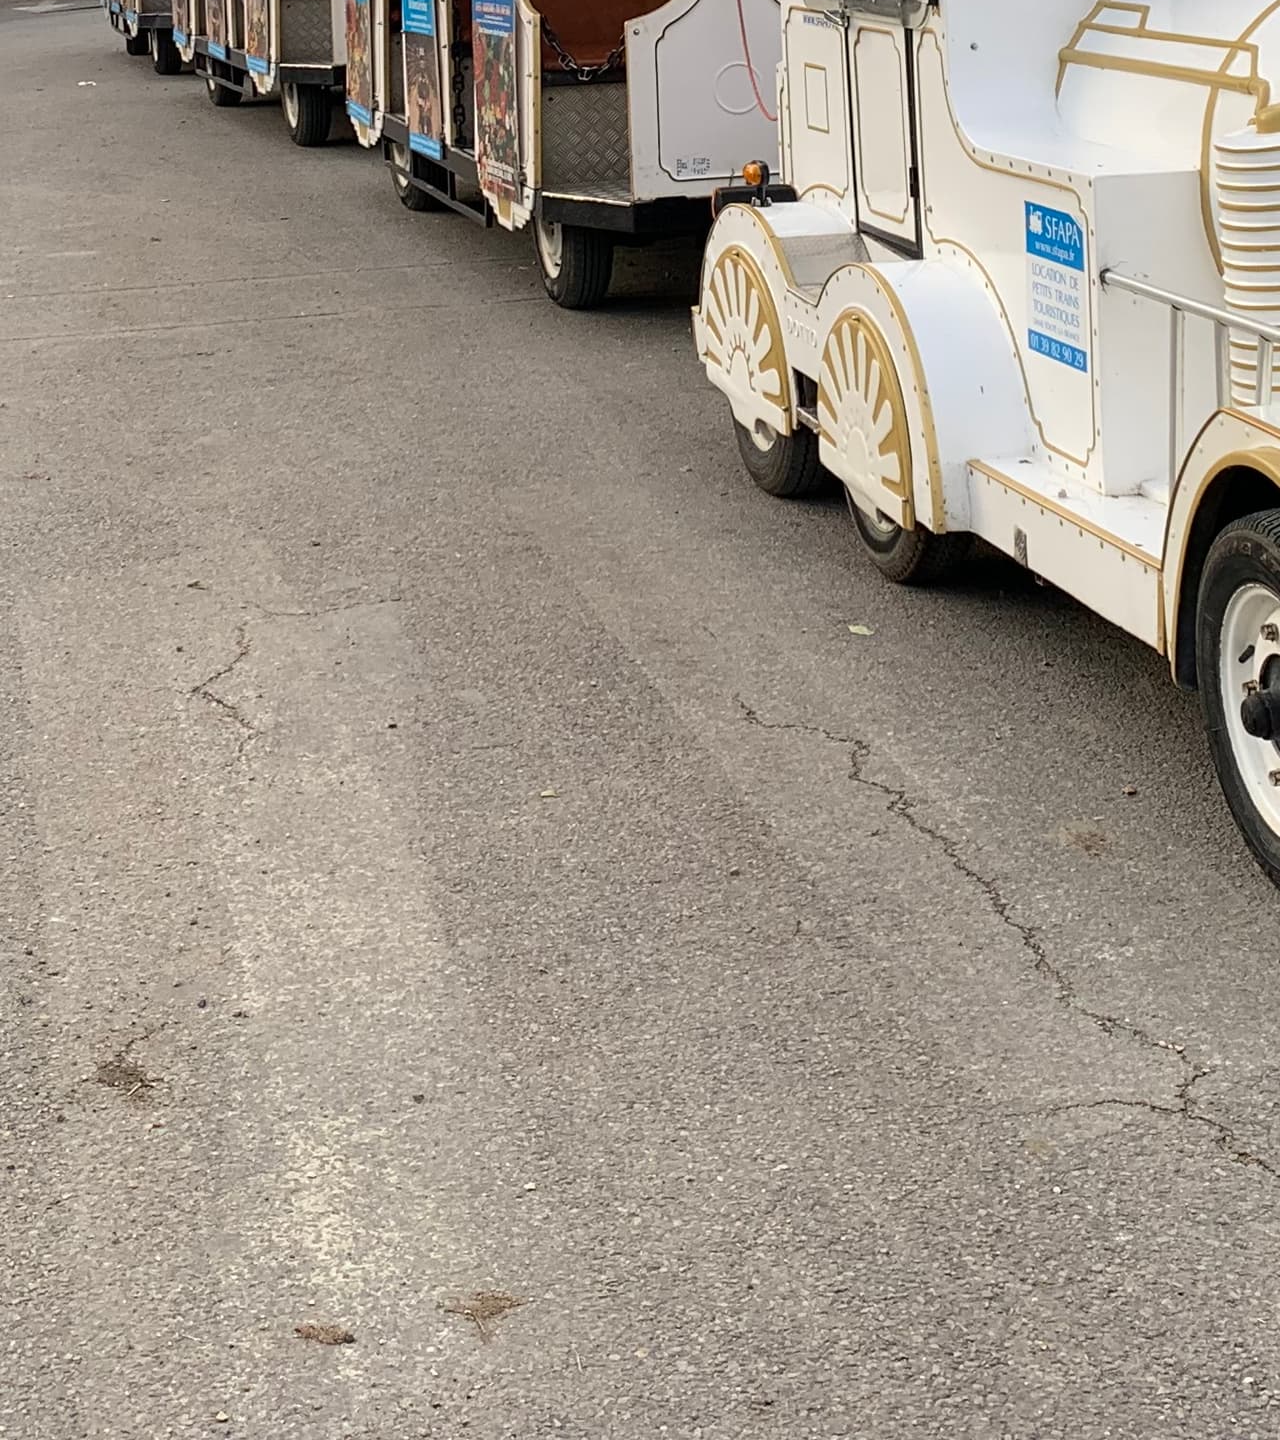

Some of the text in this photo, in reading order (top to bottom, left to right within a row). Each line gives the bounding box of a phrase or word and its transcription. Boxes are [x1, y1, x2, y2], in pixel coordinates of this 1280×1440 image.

[1045, 215, 1081, 248] SFAPA
[1032, 263, 1080, 291] LOCATION DE
[1032, 281, 1080, 310] PETITS TRAINS
[1033, 298, 1080, 328] TOURISTIQUES
